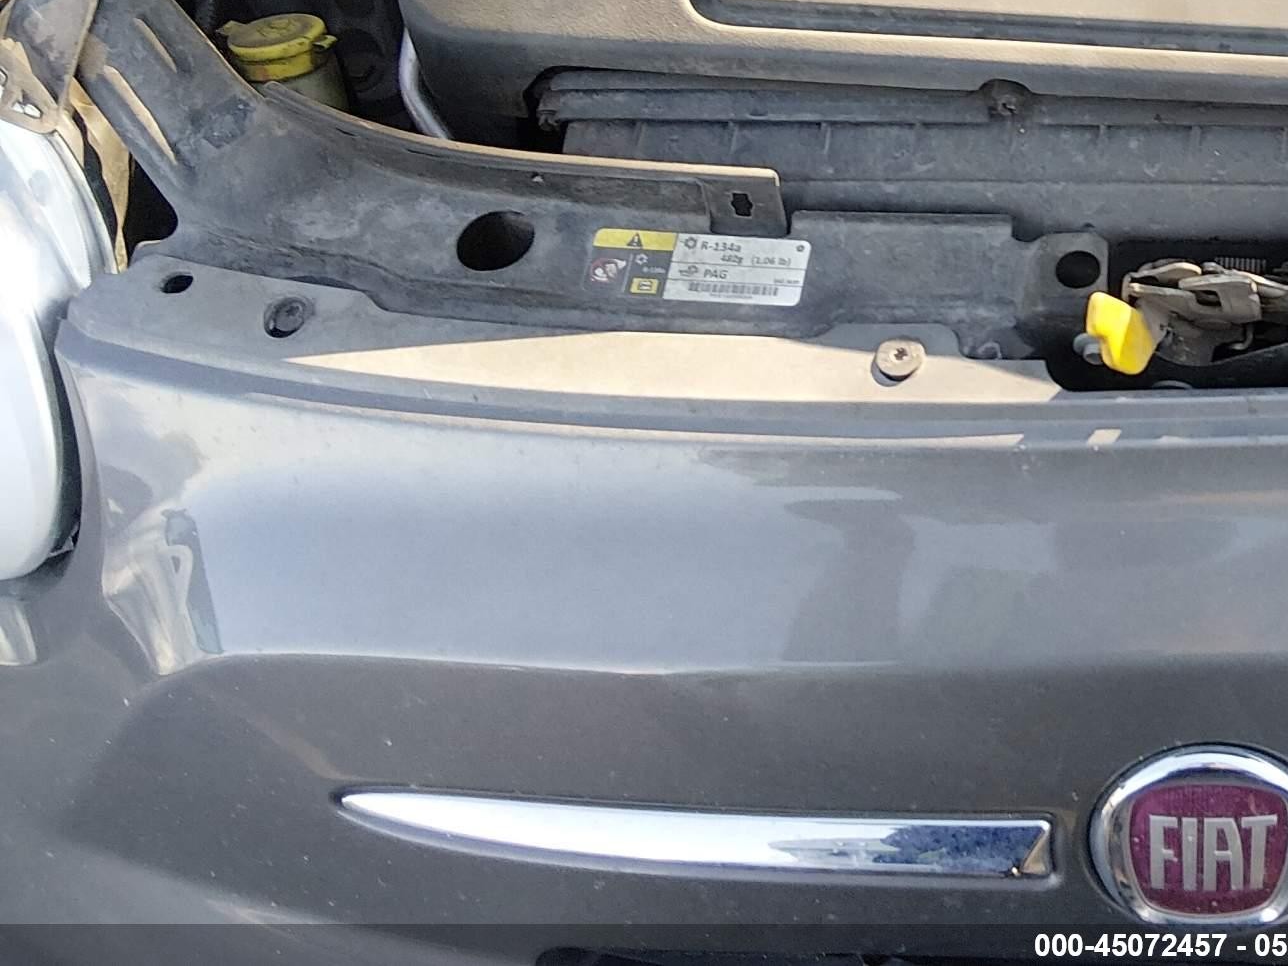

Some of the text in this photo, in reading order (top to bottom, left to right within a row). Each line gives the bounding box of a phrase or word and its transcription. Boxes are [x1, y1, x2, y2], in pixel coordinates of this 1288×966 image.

[700, 240, 742, 253] R-134a
[703, 269, 729, 280] PAG
[1149, 814, 1278, 892] FIAT
